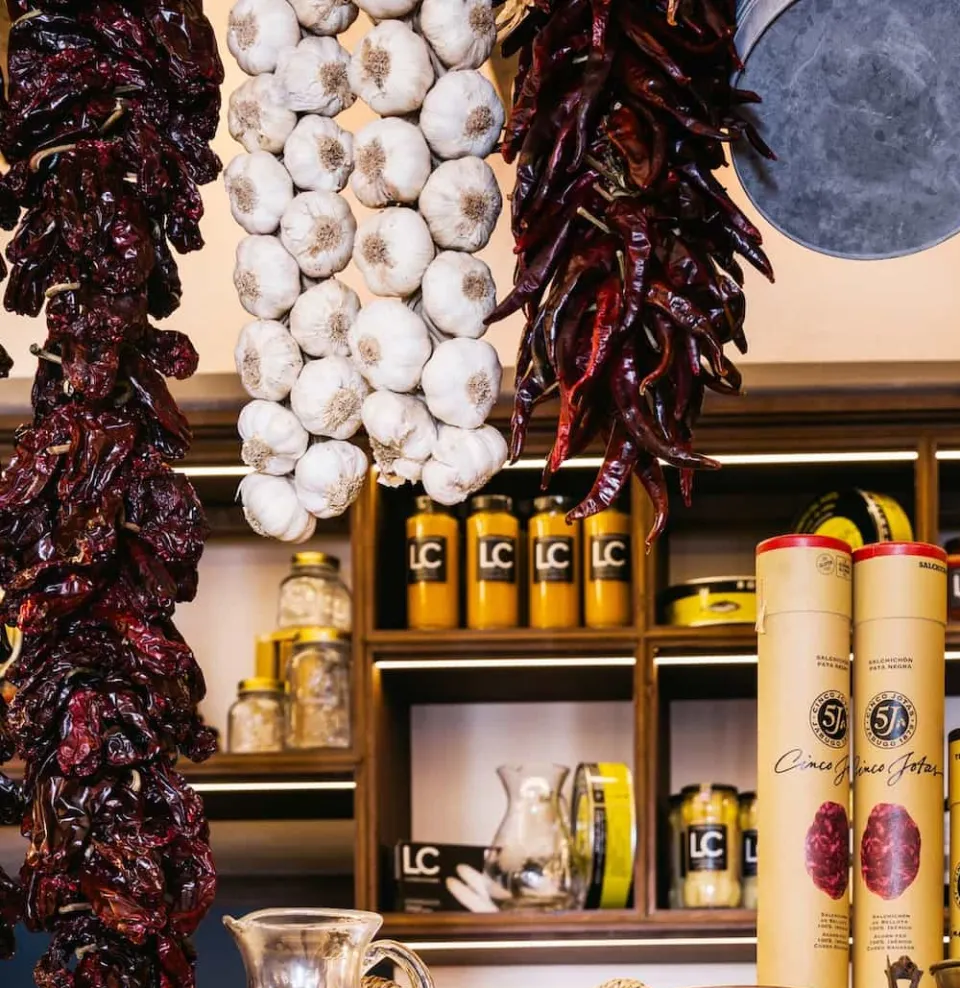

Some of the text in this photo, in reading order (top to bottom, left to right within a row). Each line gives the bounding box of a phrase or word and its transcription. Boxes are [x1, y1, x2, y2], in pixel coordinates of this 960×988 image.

[410, 541, 442, 569] LC
[480, 541, 514, 569] LC
[536, 541, 569, 569] LC
[592, 540, 626, 567] LC
[822, 704, 844, 735] 5J
[874, 705, 902, 737] 5J
[887, 752, 943, 786] Jotas
[690, 830, 723, 859] LC
[403, 847, 440, 875] LC
